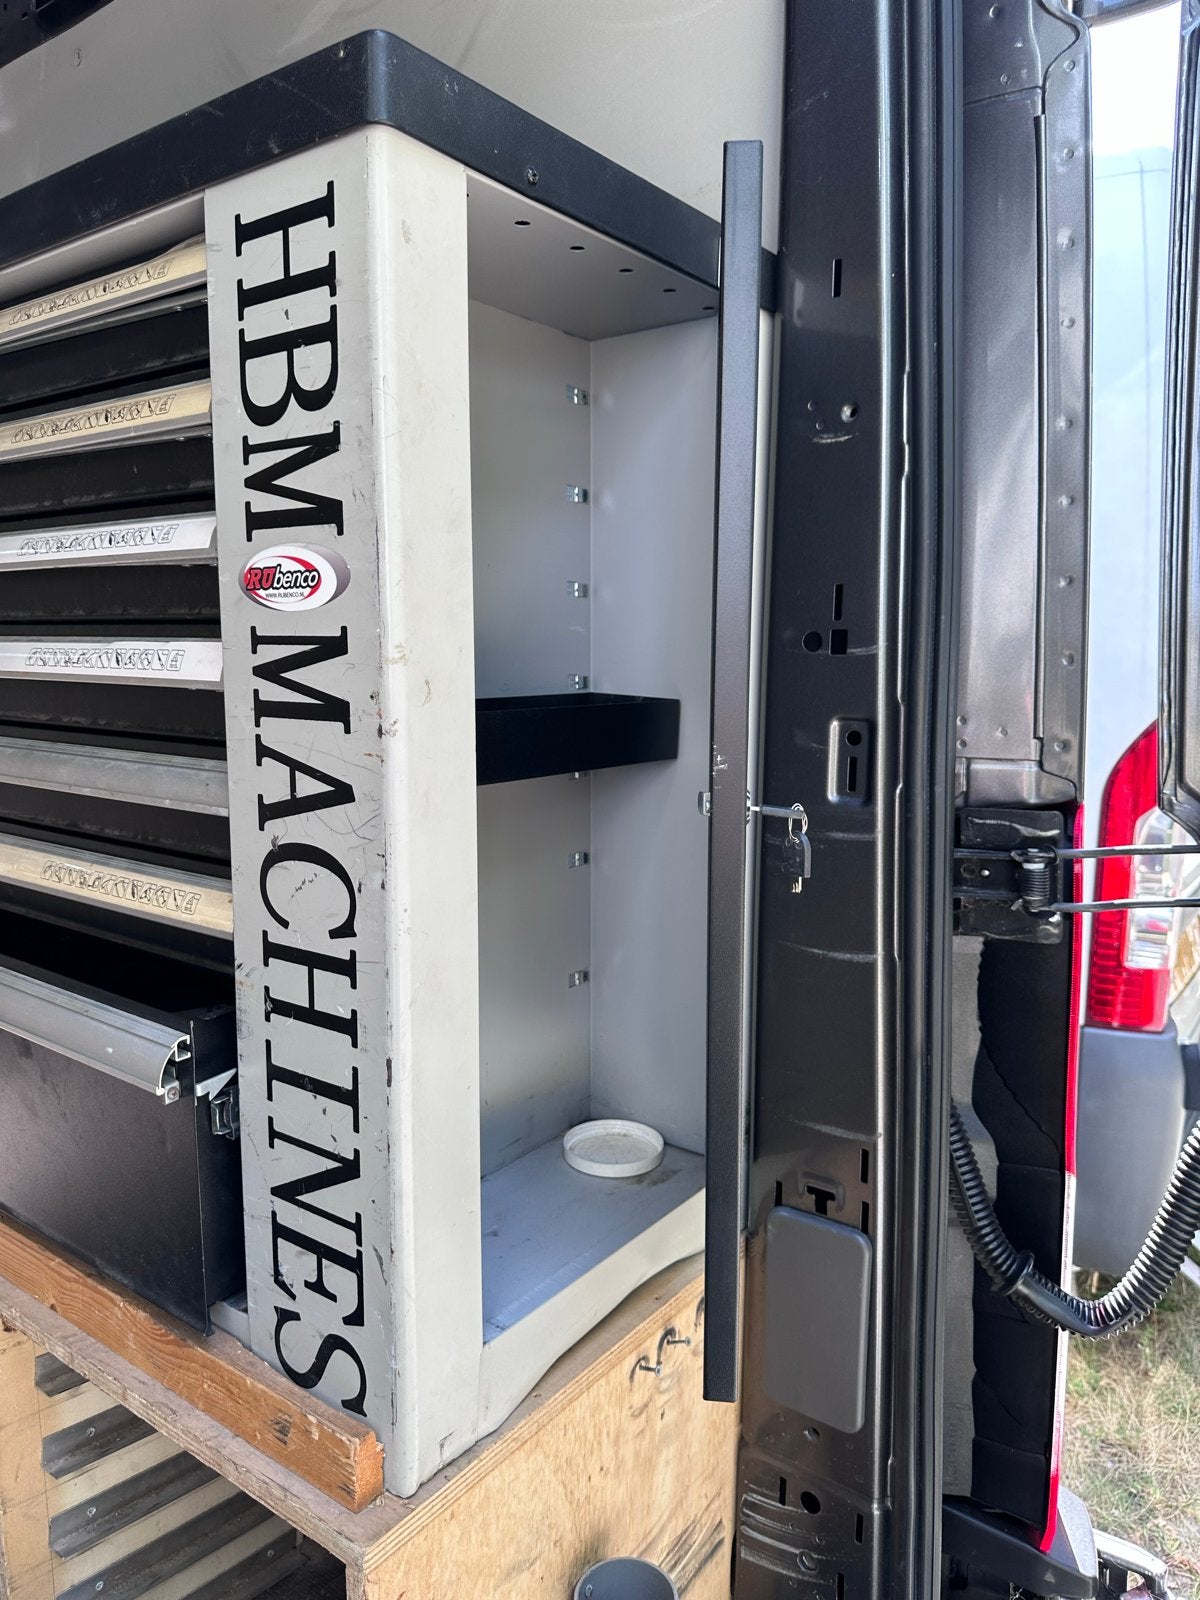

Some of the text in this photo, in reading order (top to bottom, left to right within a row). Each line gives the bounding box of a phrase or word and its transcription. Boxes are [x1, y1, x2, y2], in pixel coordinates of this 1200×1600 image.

[235, 180, 367, 1417] HBM MACHINES
[265, 591, 305, 599] WWW.RUBENCO.NL
